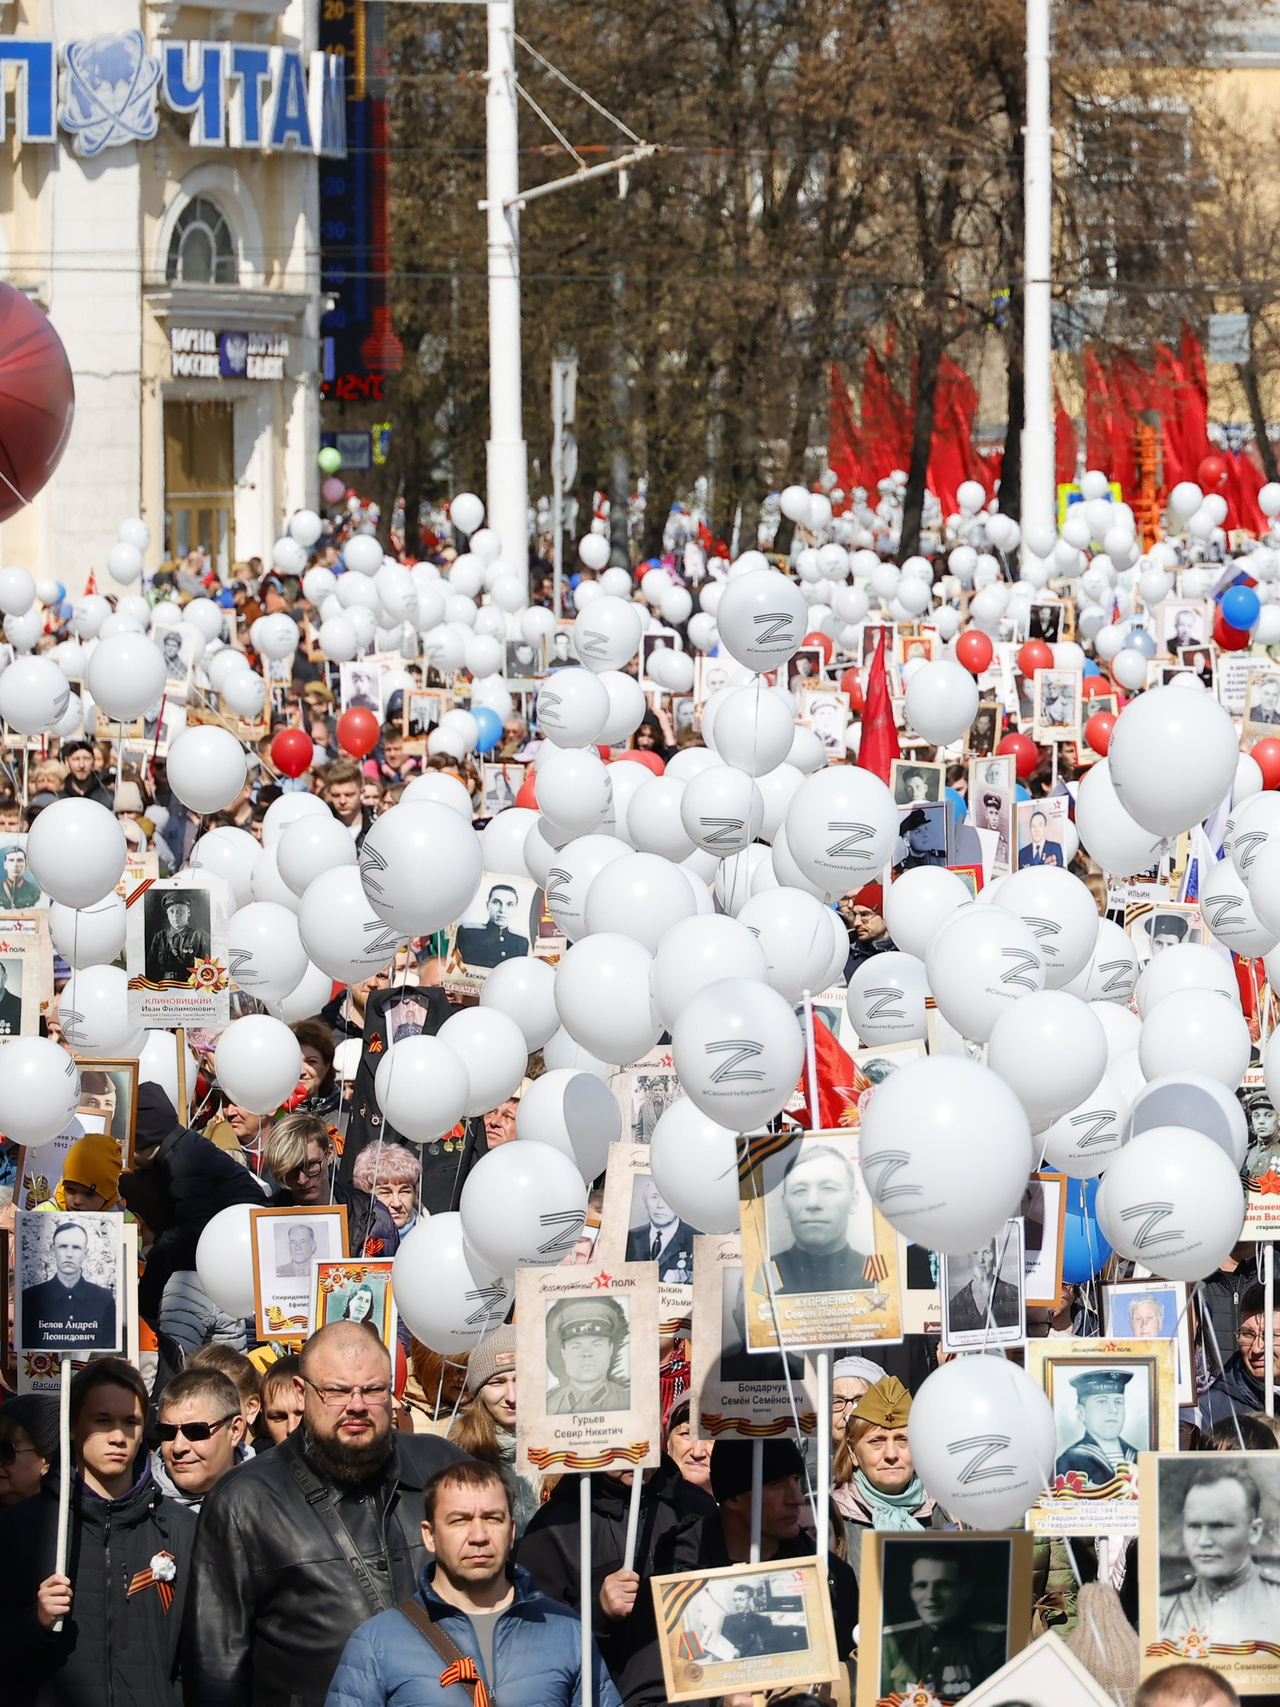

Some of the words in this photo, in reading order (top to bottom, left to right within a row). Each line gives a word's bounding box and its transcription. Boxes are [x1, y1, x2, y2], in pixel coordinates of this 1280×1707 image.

[145, 997, 212, 1006] КЛИНОВИЦКИЙ
[162, 1005, 216, 1013] Филимонович
[705, 1039, 767, 1084] Z
[794, 1293, 856, 1309] КУПРИЕНКО
[784, 1307, 816, 1321] Семён
[819, 1305, 868, 1318] Павлович
[38, 1320, 64, 1329] Белов
[65, 1320, 99, 1331] Андрей
[42, 1332, 96, 1342] Леонидович
[738, 1382, 787, 1394] Бондарчук
[721, 1396, 750, 1406] Семён
[751, 1394, 804, 1405] Семёнович
[571, 1415, 605, 1426] Гурьев
[554, 1428, 583, 1440] Севир
[585, 1426, 623, 1438] Никитич
[946, 1433, 1018, 1485] Z
[1080, 1499, 1111, 1508] Михаил
[1251, 1672, 1280, 1685] ПОЛК
